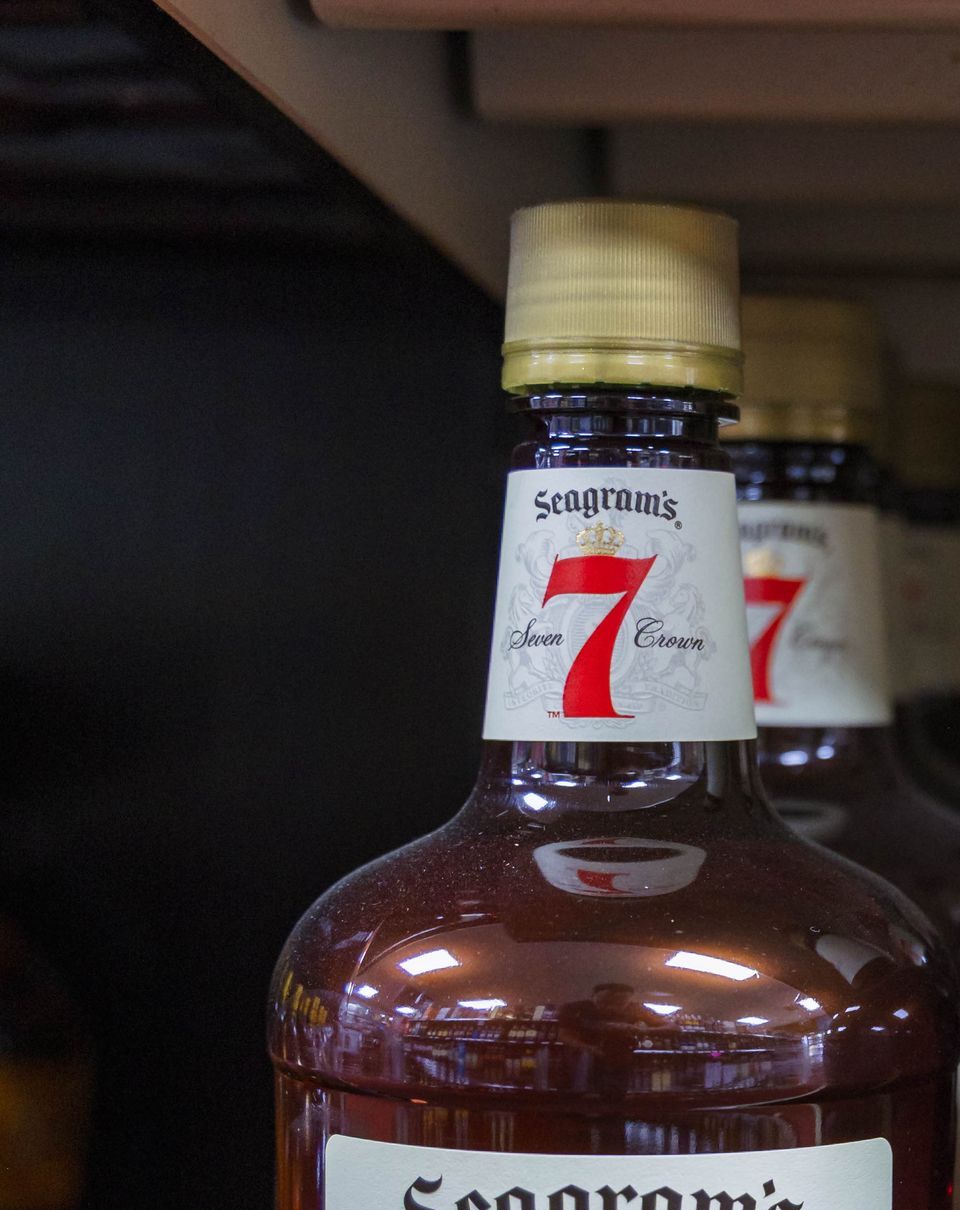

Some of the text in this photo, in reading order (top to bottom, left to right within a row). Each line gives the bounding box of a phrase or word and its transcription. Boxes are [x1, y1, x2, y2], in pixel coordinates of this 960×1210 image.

[533, 487, 679, 521] Seagram's
[508, 616, 706, 651] Seven Crown
[542, 554, 658, 718] 7
